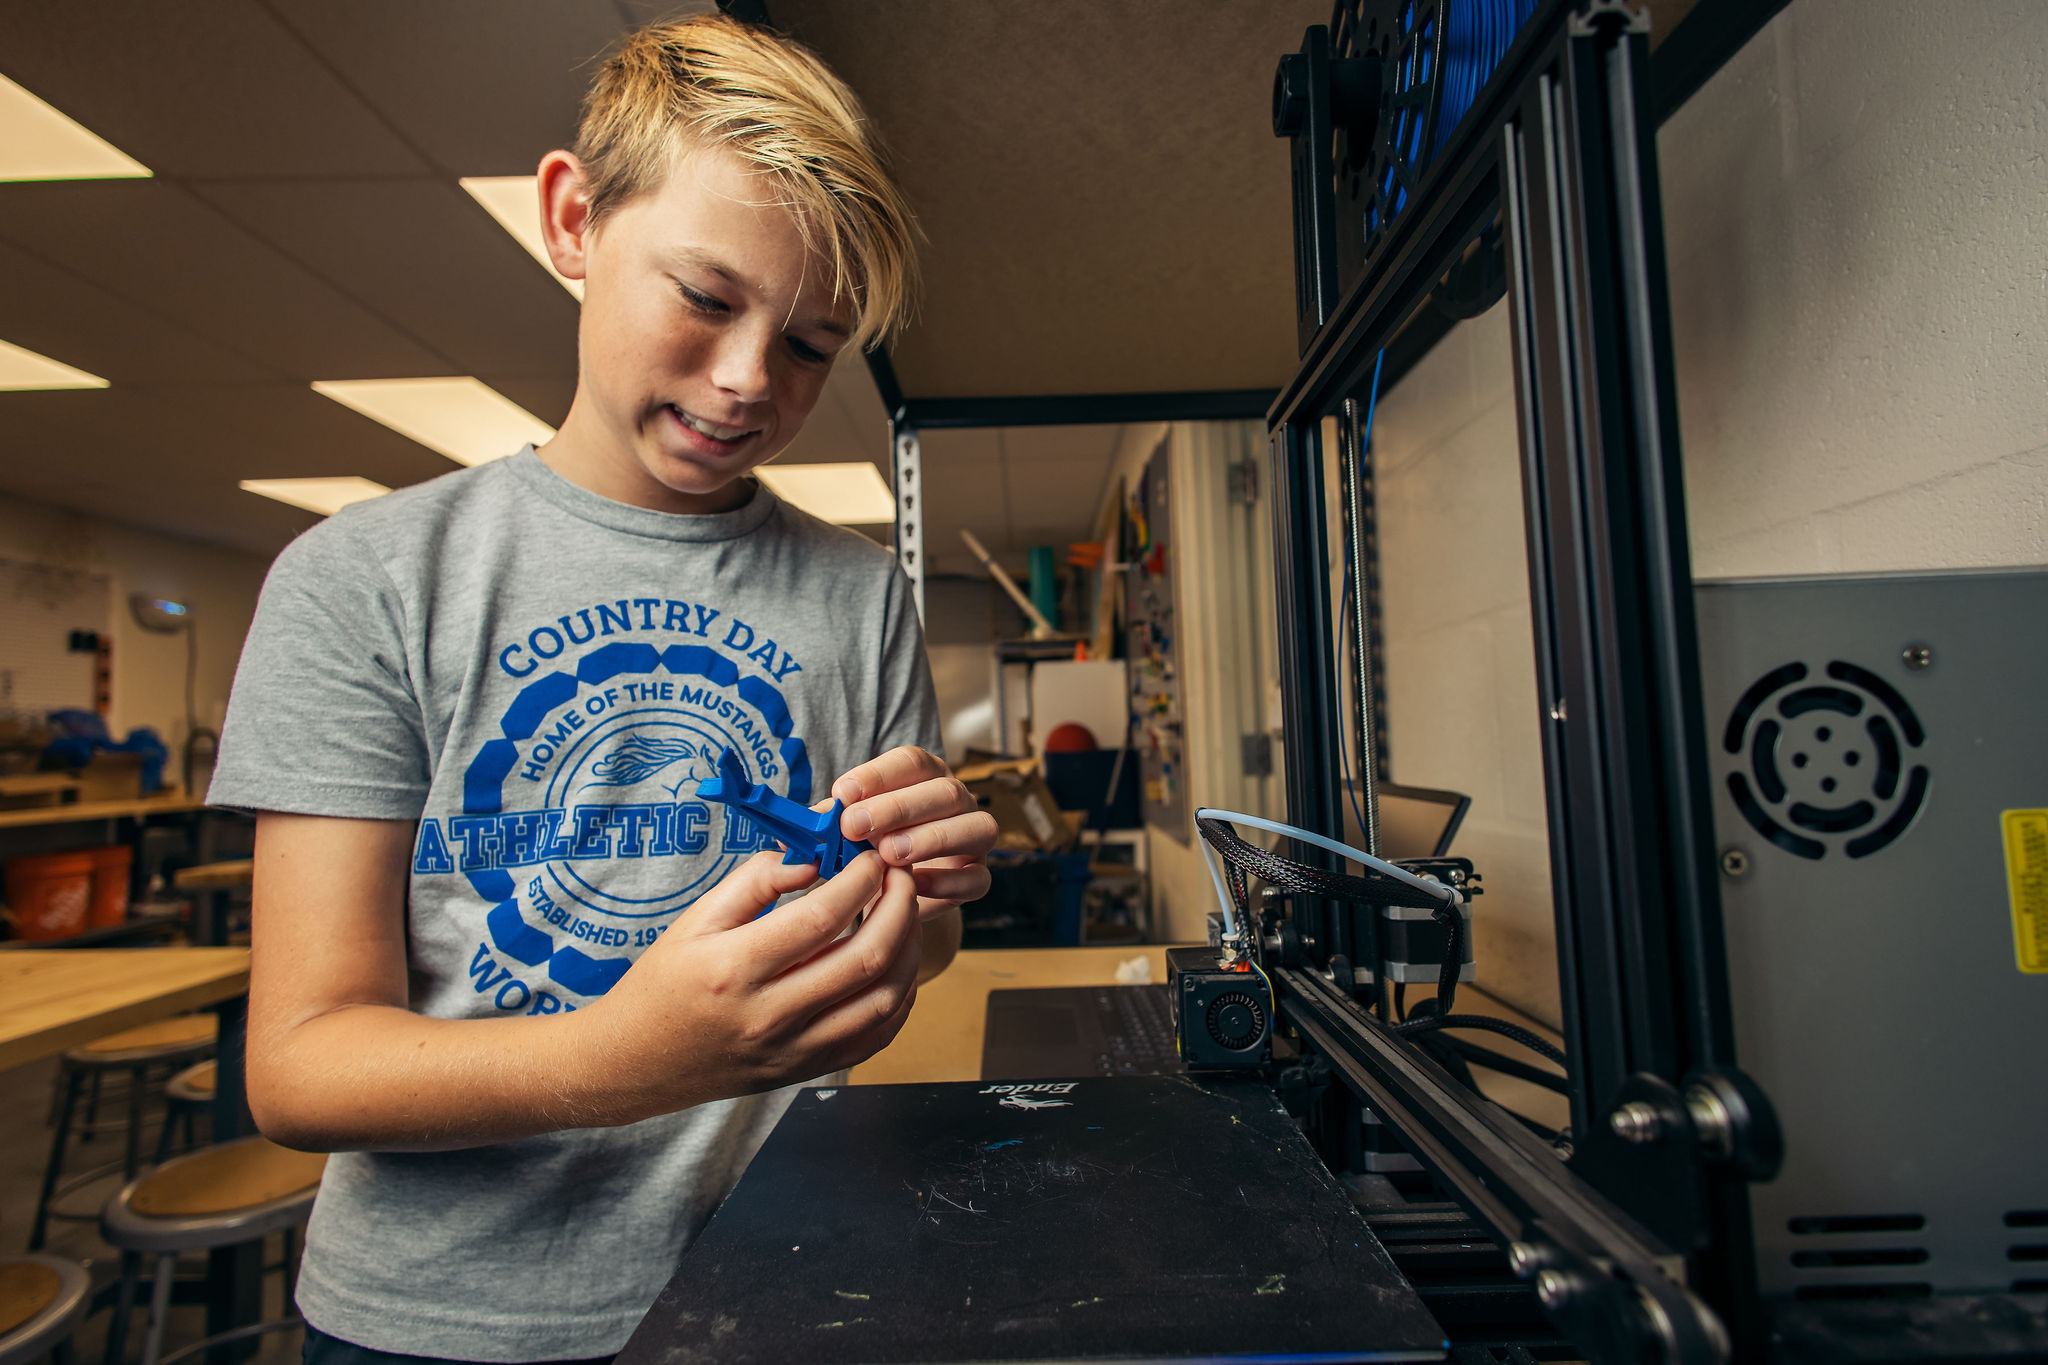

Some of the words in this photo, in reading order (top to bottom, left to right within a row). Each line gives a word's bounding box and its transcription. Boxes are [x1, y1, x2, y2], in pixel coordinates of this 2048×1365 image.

[499, 598, 720, 679] COUNTRY
[722, 619, 803, 684] DAY
[520, 709, 586, 782] HOME
[585, 688, 620, 716] OF
[622, 682, 674, 702] THE
[680, 685, 779, 780] MUSTANGS
[413, 802, 712, 875] ATHLETIC
[528, 875, 629, 948] ESTABLISHED
[469, 942, 577, 1017] WOR
[978, 1082, 1080, 1096] Ender
